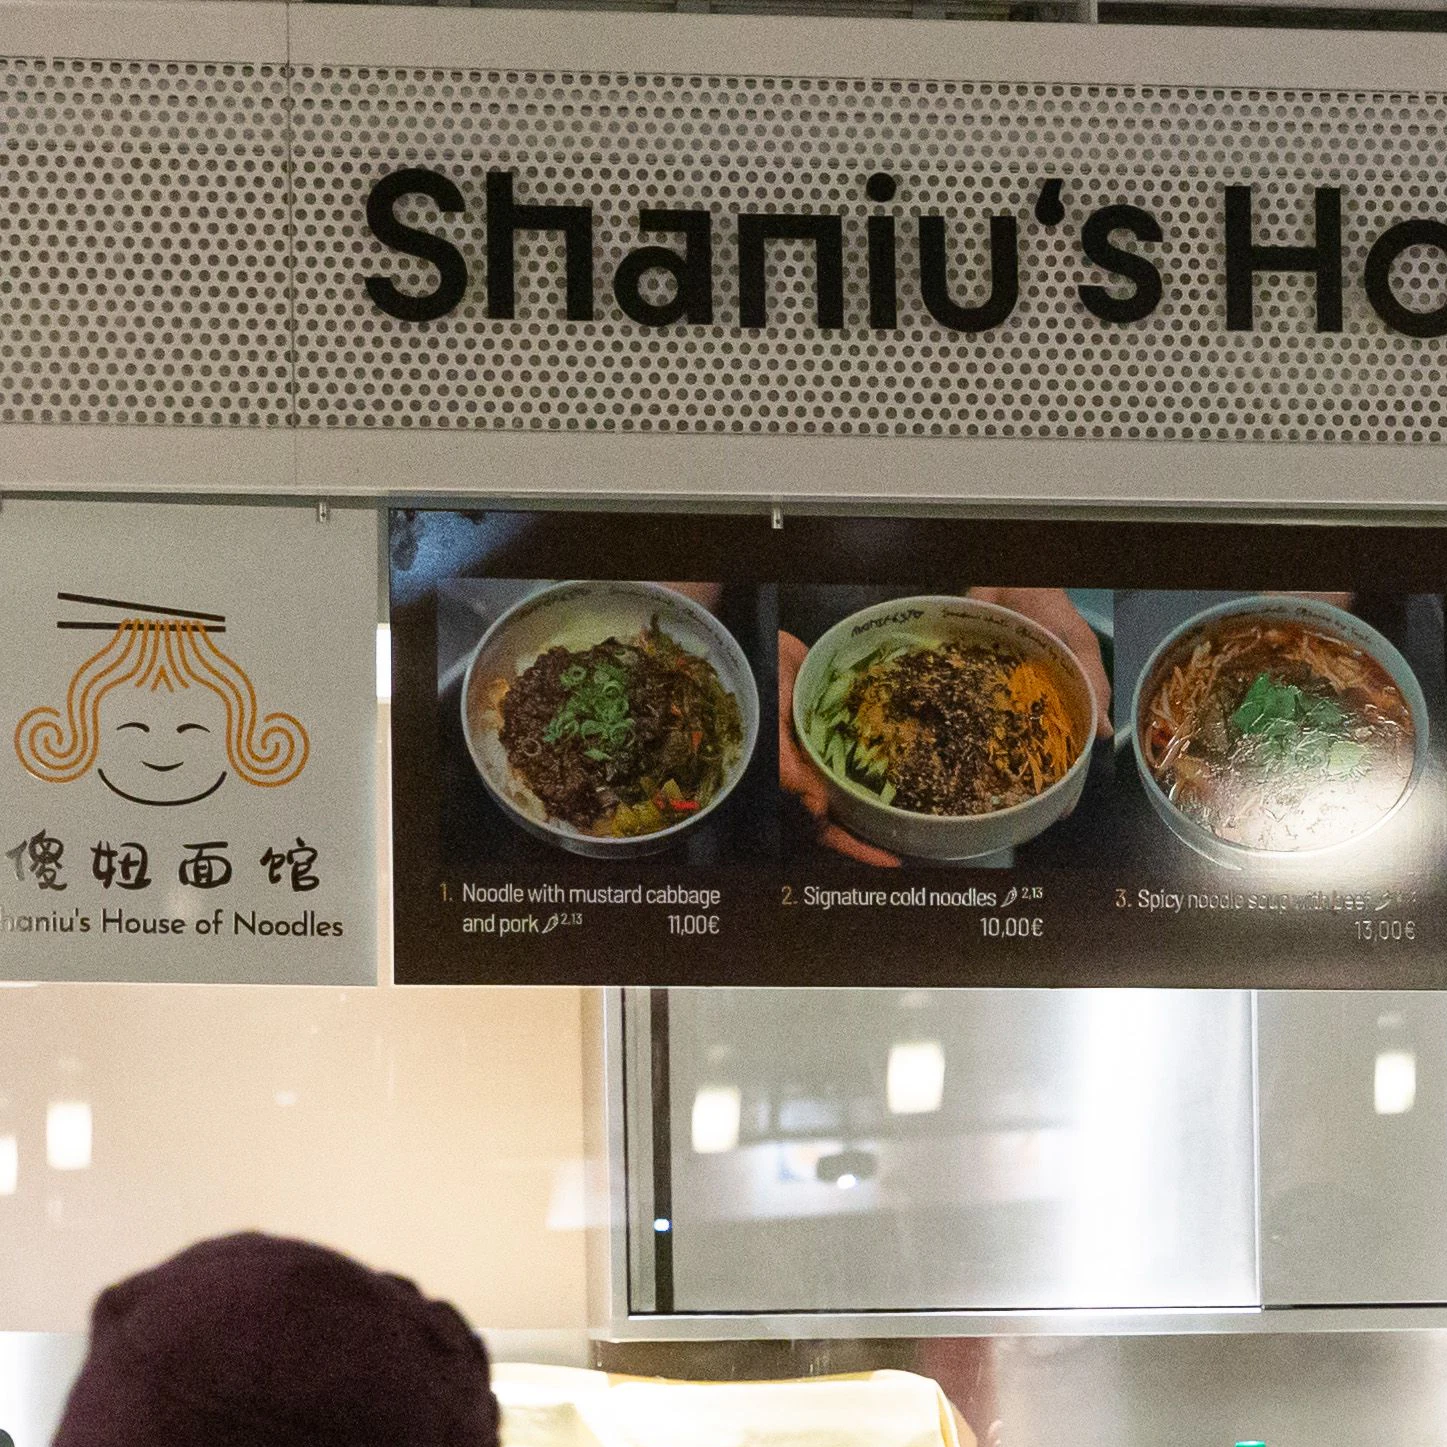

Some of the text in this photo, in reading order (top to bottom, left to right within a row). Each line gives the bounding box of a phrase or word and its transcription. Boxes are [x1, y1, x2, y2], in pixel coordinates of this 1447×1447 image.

[363, 168, 1164, 333] Shaniu's
[463, 883, 720, 908] Noodle with mustard cabbage
[781, 885, 996, 909] 2. Signature cold noodles
[1115, 888, 1131, 908] 3.
[1138, 888, 1183, 912] Spicy
[0, 906, 343, 937] haniu's House of Noodles
[463, 914, 720, 938] and pork 11,00€
[980, 917, 1043, 938] 10,00€
[1354, 920, 1416, 941] 13,00€
